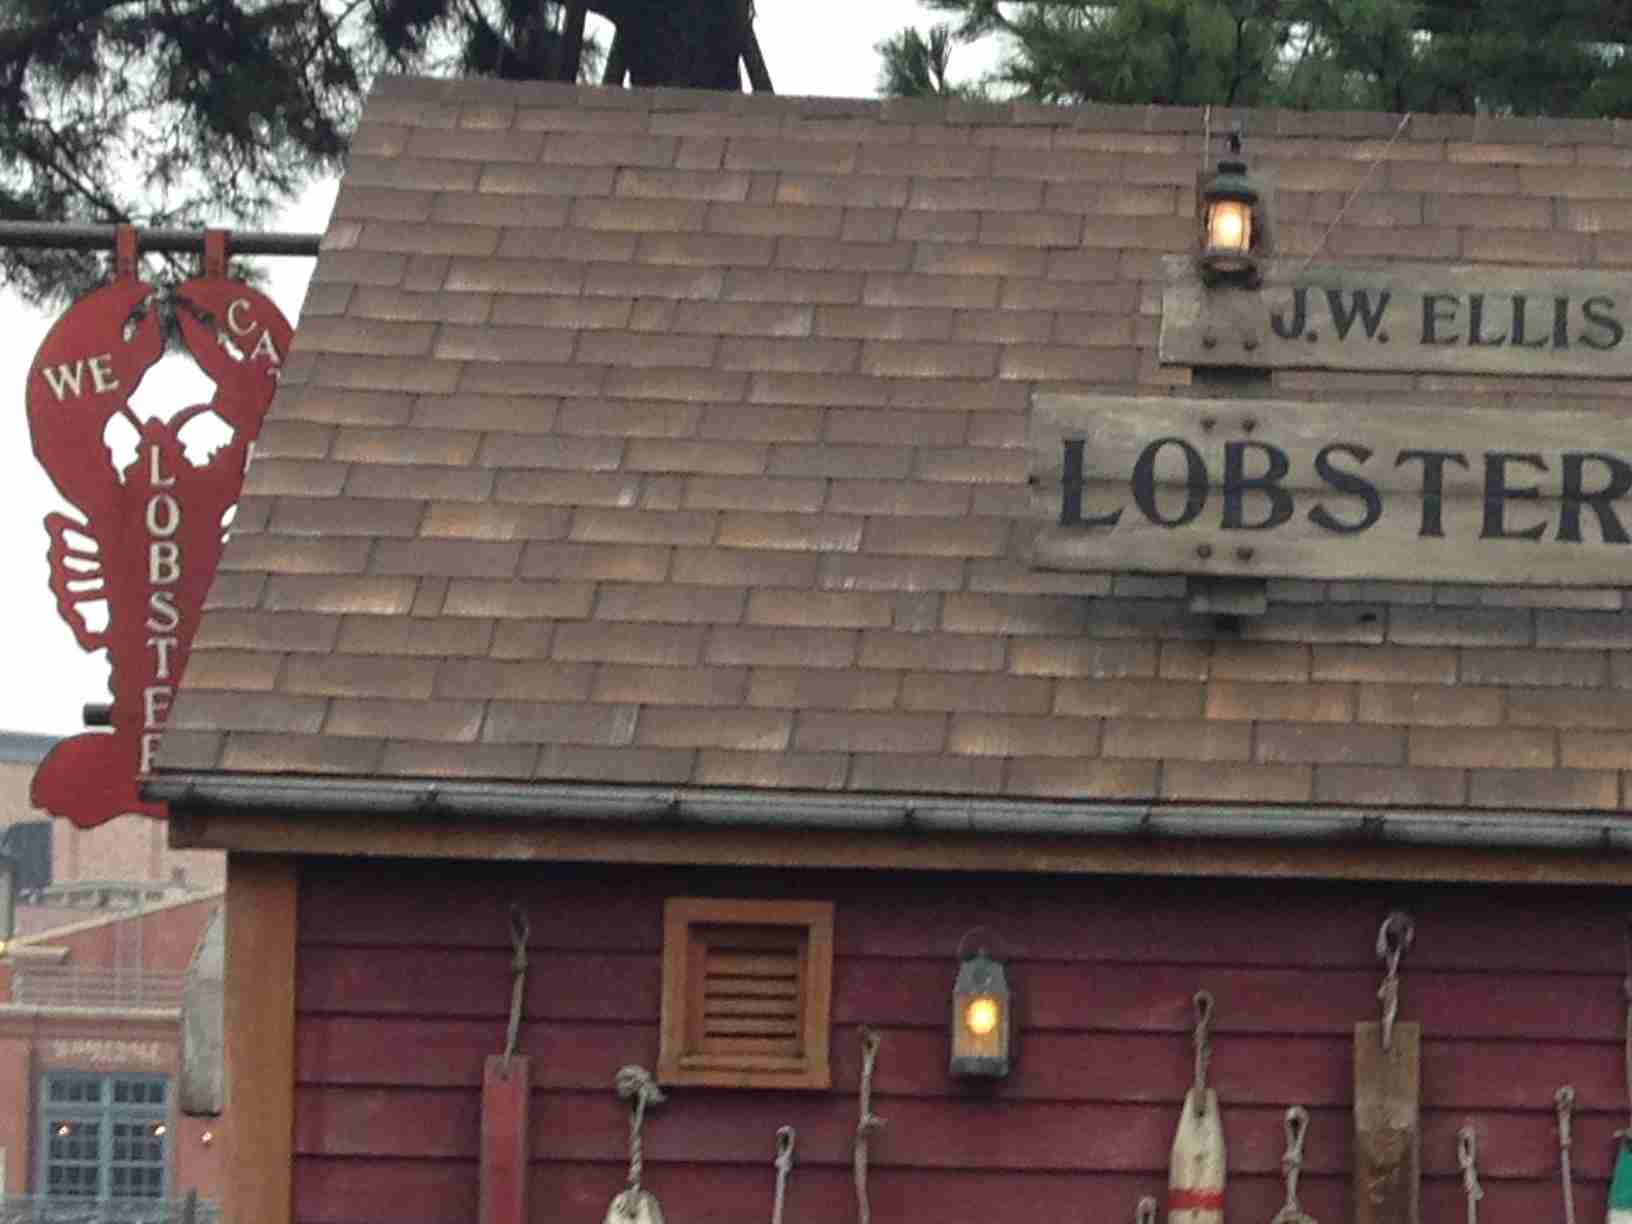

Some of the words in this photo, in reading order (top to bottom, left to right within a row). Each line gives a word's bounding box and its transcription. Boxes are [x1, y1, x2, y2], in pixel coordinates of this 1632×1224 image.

[1269, 287, 1391, 343] J.W.
[1420, 292, 1624, 350] ELLIS
[43, 353, 119, 402] WE
